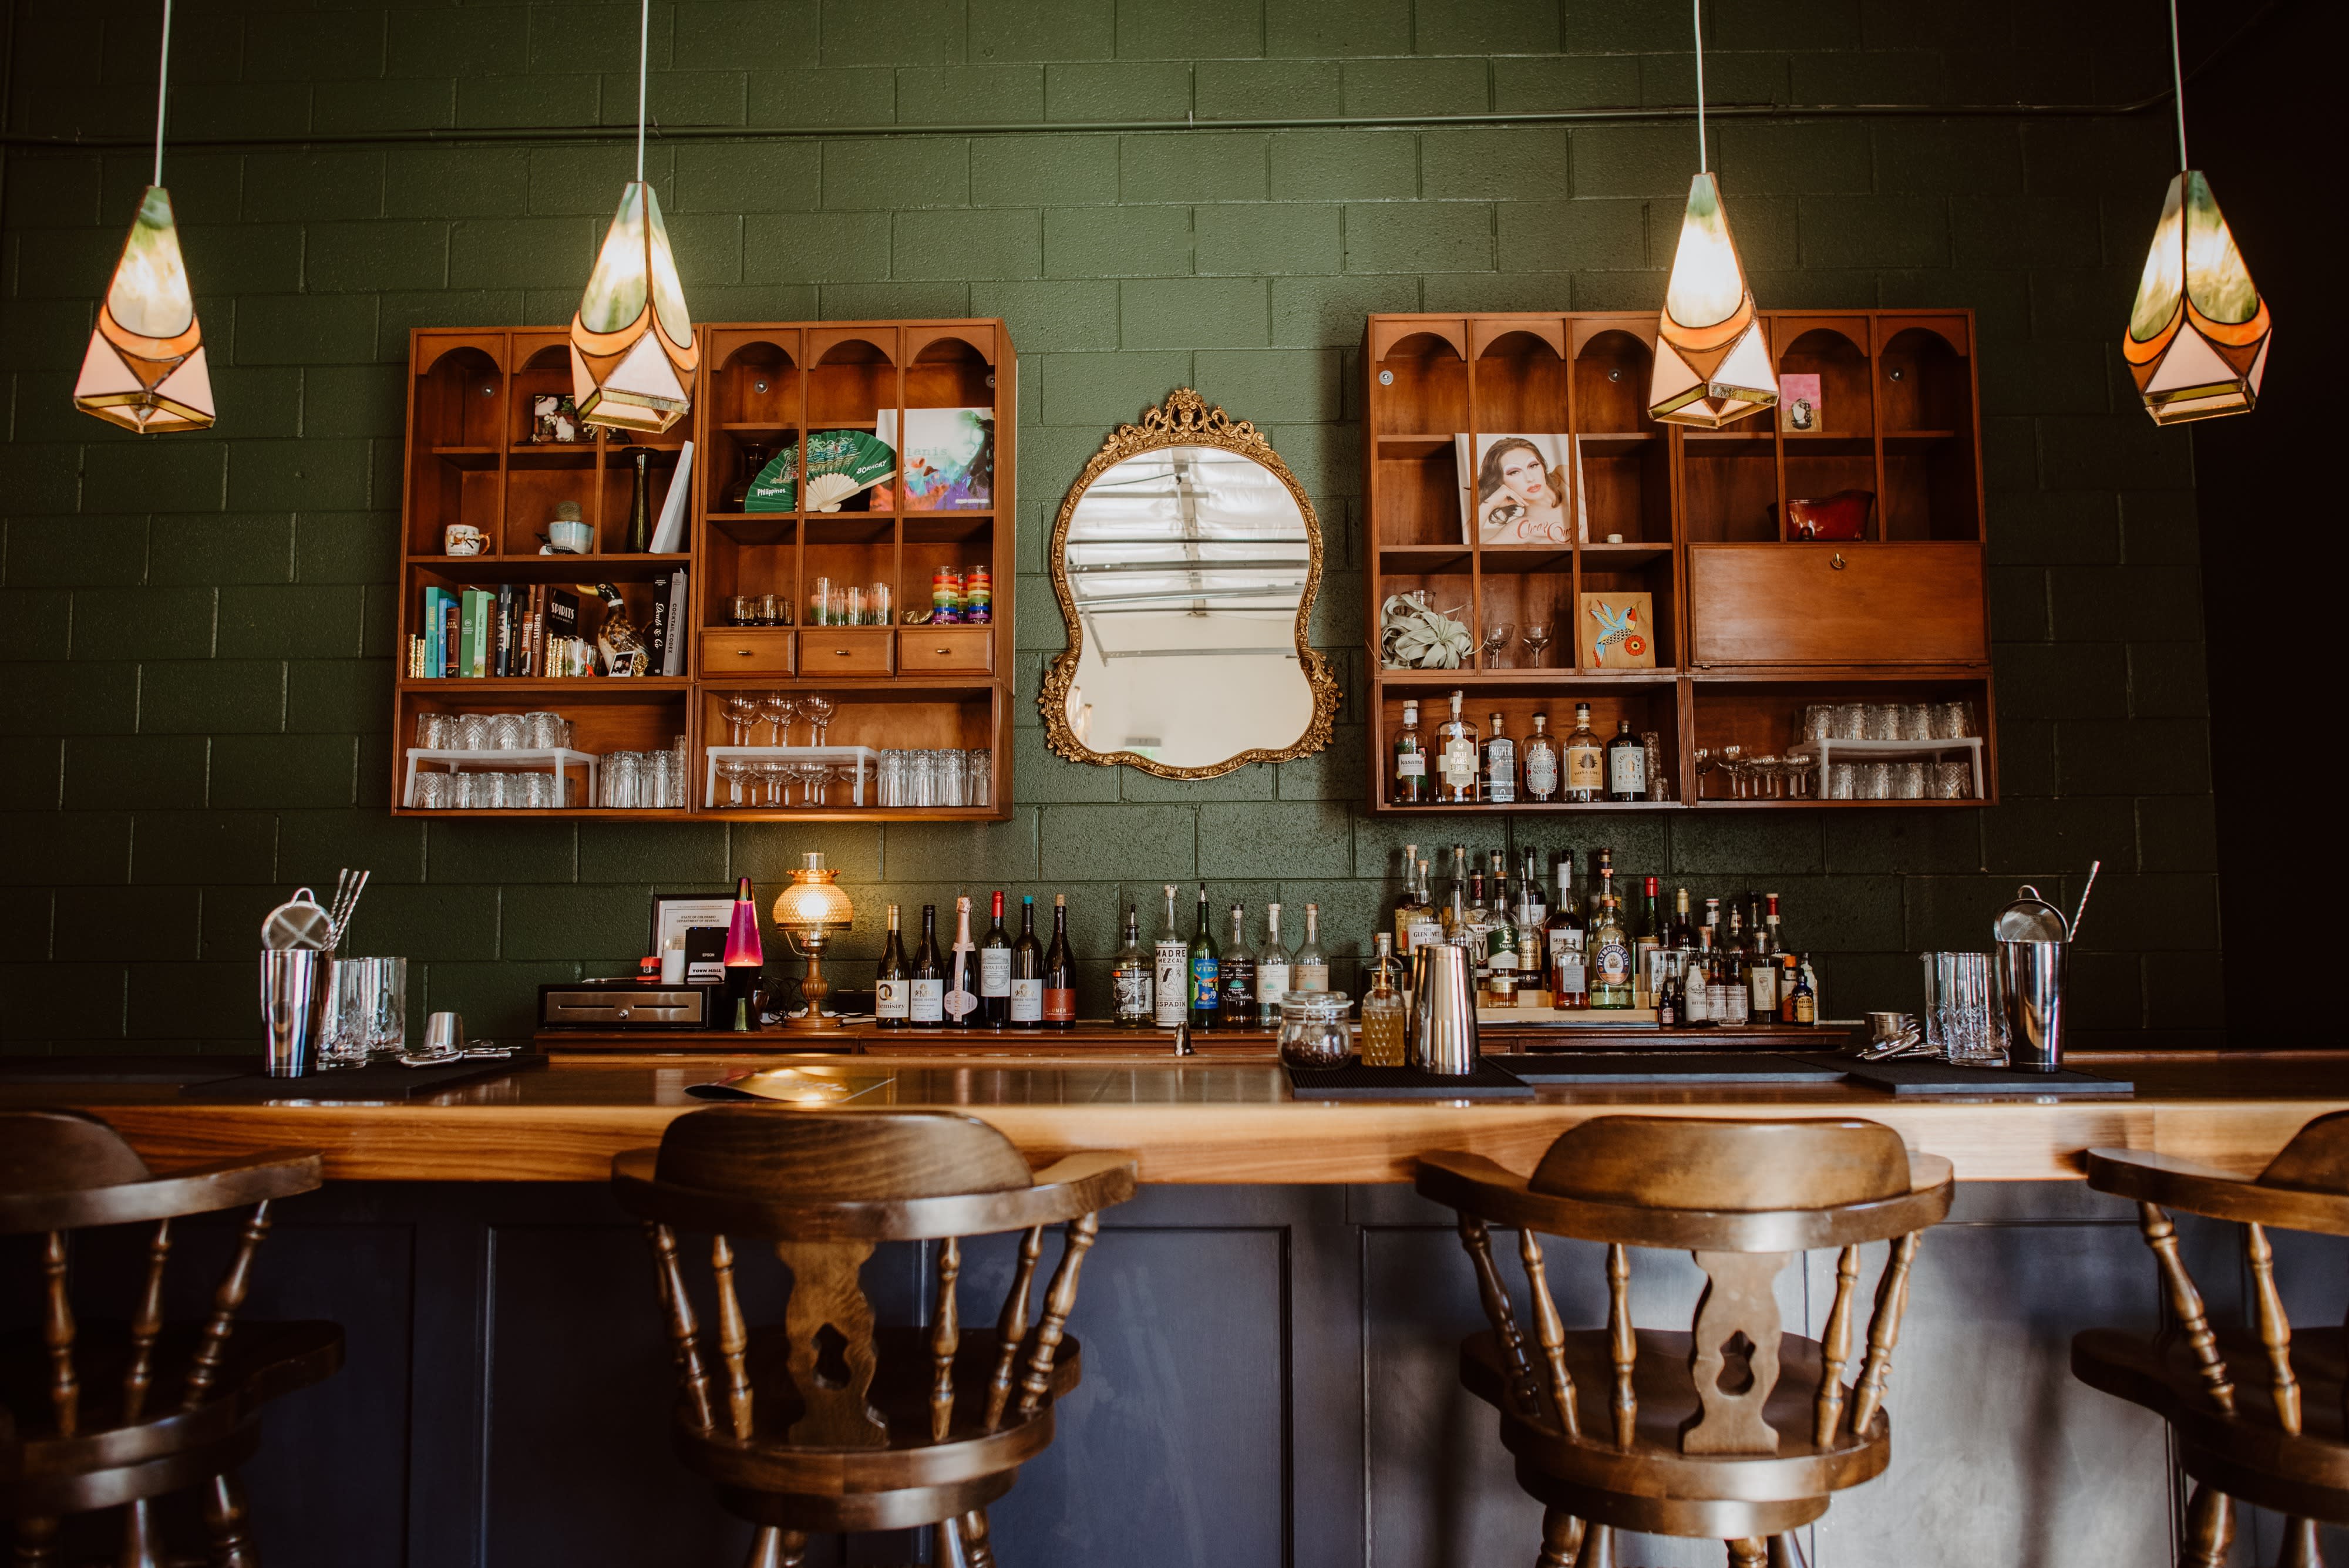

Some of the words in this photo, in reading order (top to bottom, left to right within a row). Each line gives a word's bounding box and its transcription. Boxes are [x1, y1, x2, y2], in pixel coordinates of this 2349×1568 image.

[906, 446, 948, 456] lanis
[856, 460, 887, 475] BORACAY
[757, 488, 786, 497] Philippines
[551, 602, 574, 620] SPIRITS
[655, 602, 665, 626] Death
[533, 614, 541, 639] SPIRITS
[654, 628, 662, 637] &
[654, 638, 663, 649] Co
[1597, 945, 1624, 965] PLYMOUTH
[954, 972, 963, 1019] CHANDON
